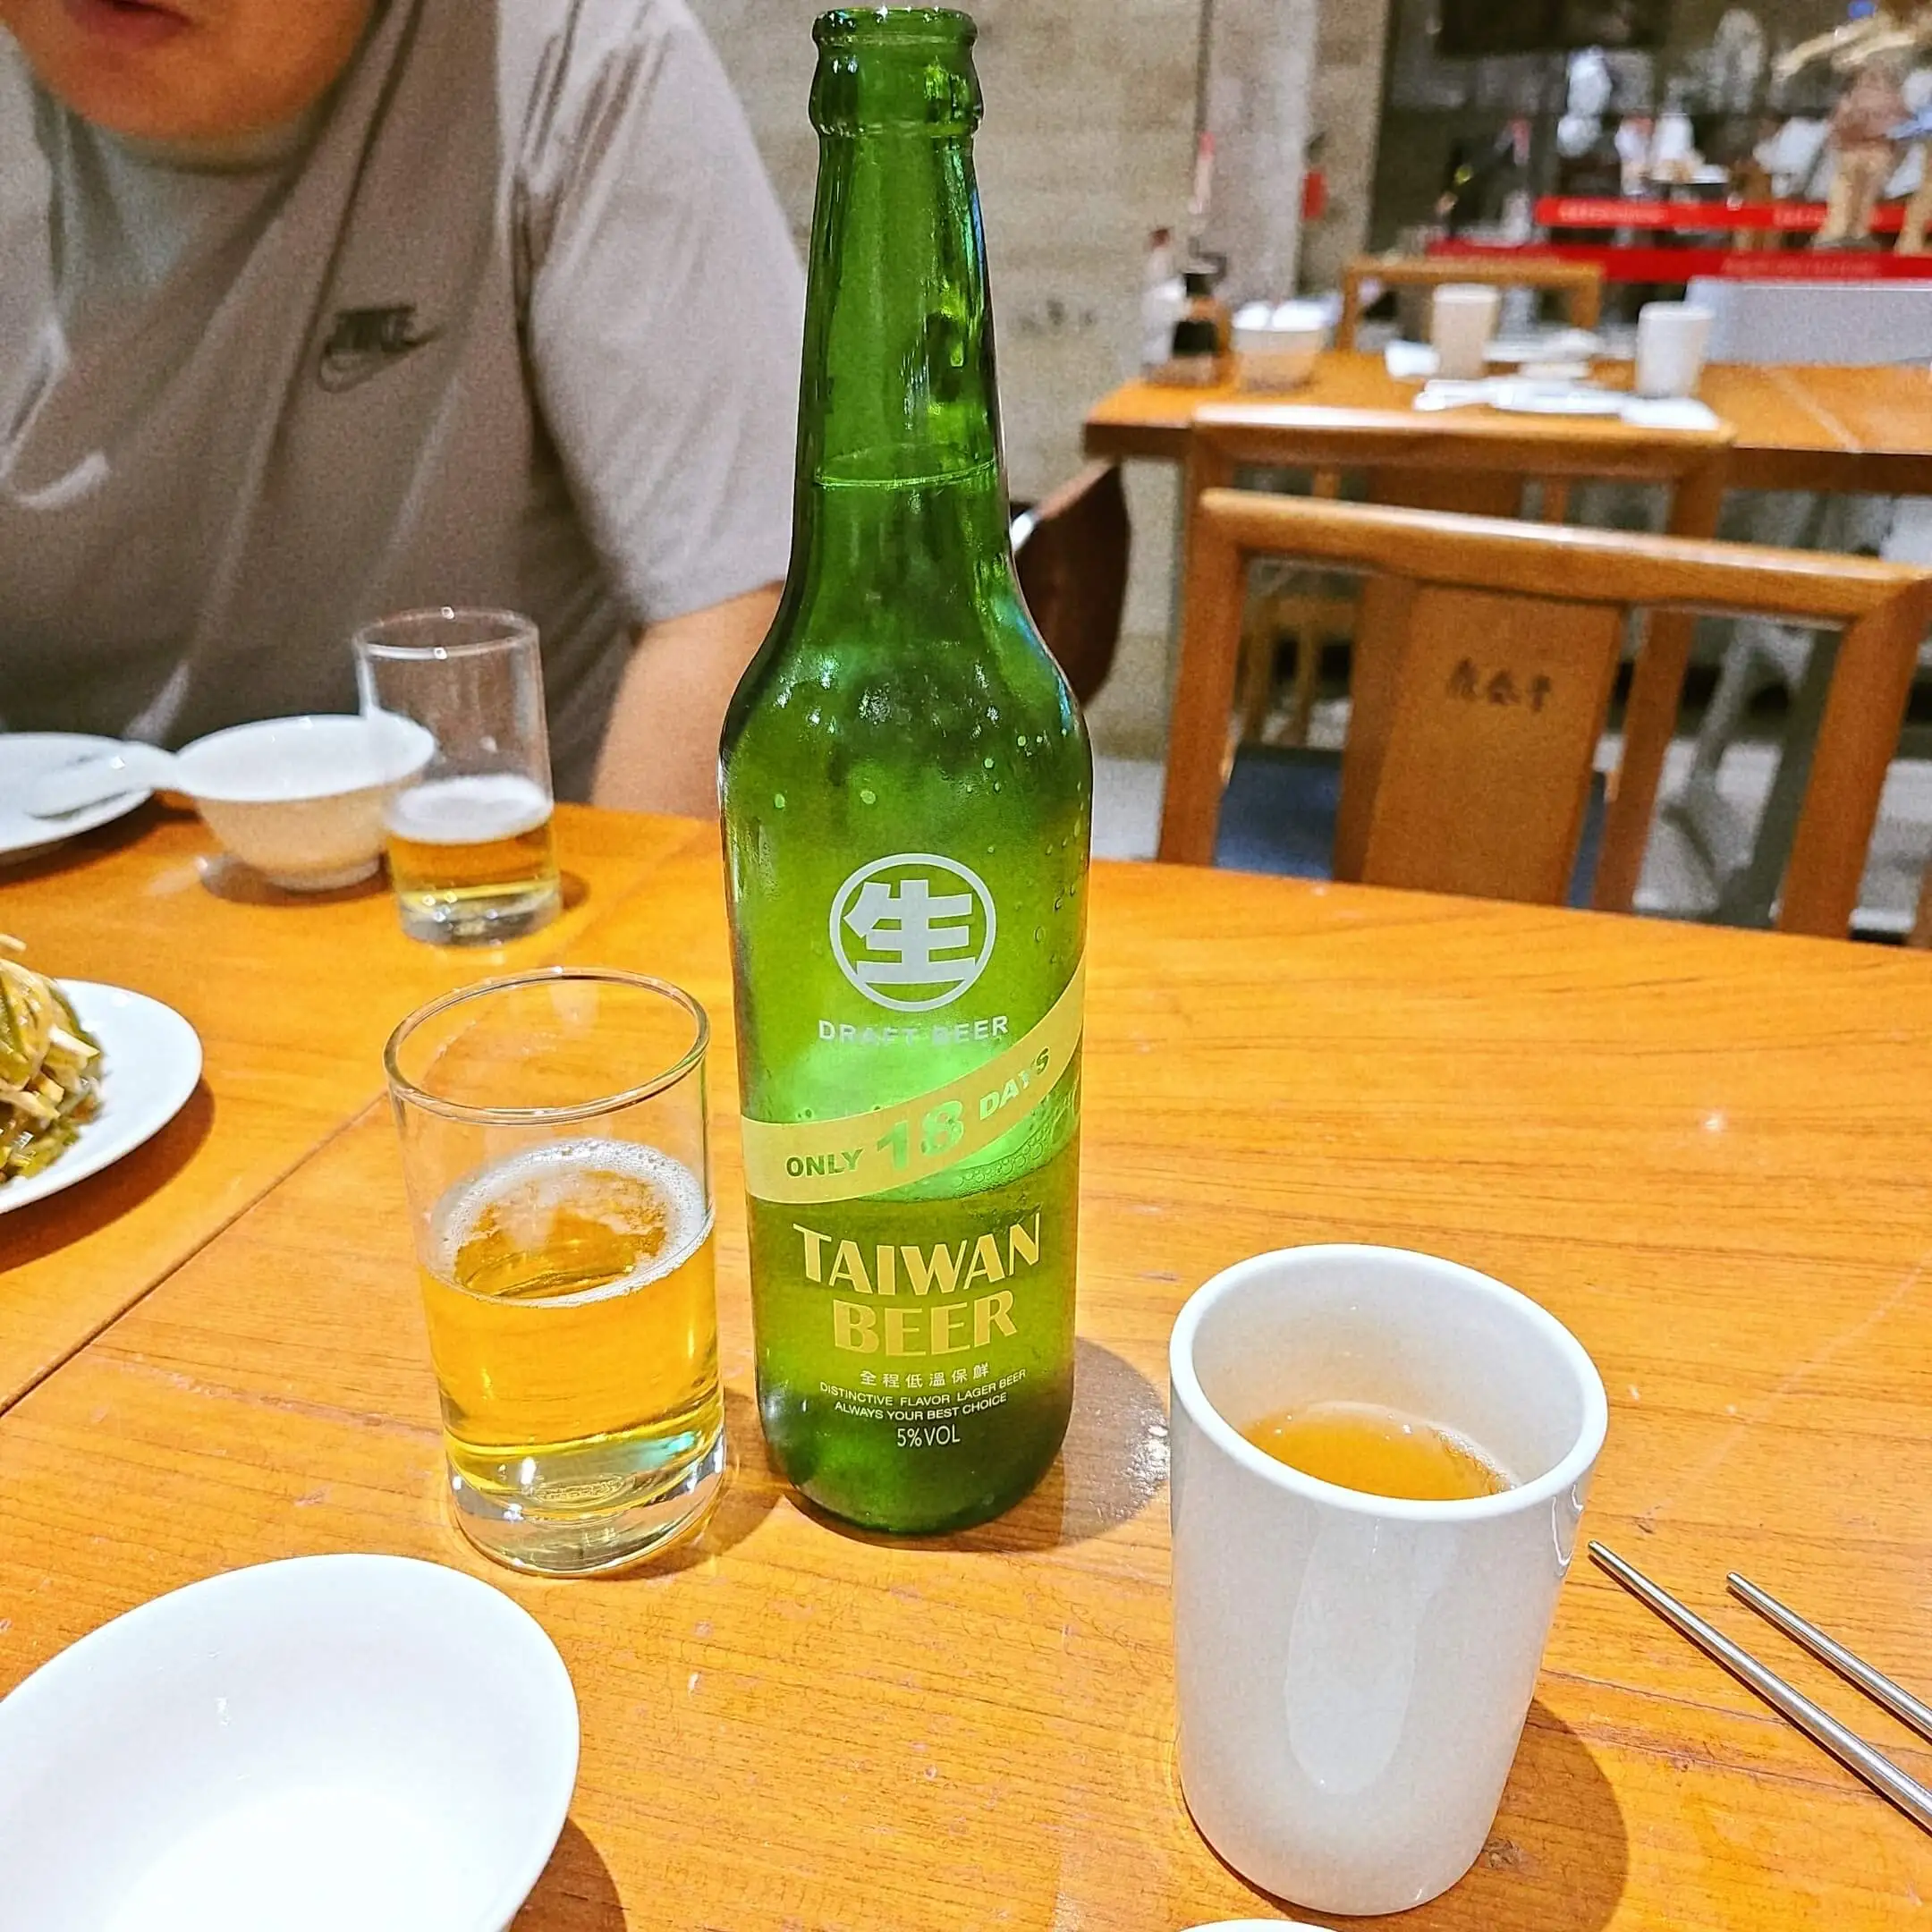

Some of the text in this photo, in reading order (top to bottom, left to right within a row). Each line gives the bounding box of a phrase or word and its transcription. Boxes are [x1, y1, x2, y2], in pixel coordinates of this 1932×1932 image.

[843, 879, 979, 985] 生
[818, 1016, 1009, 1046] DRAFT BEER
[786, 1148, 864, 1178] ONLY
[877, 1100, 964, 1171] 18
[792, 1212, 1041, 1296] TAIWAN
[833, 1290, 1018, 1357] BEER
[819, 1368, 1027, 1407] DISTINCTIVE FLAVOR LAGER BEER
[860, 1362, 989, 1389] 全程低溫保鮮
[835, 1391, 1008, 1421] ALWAYS YOUR BEST CHOICE
